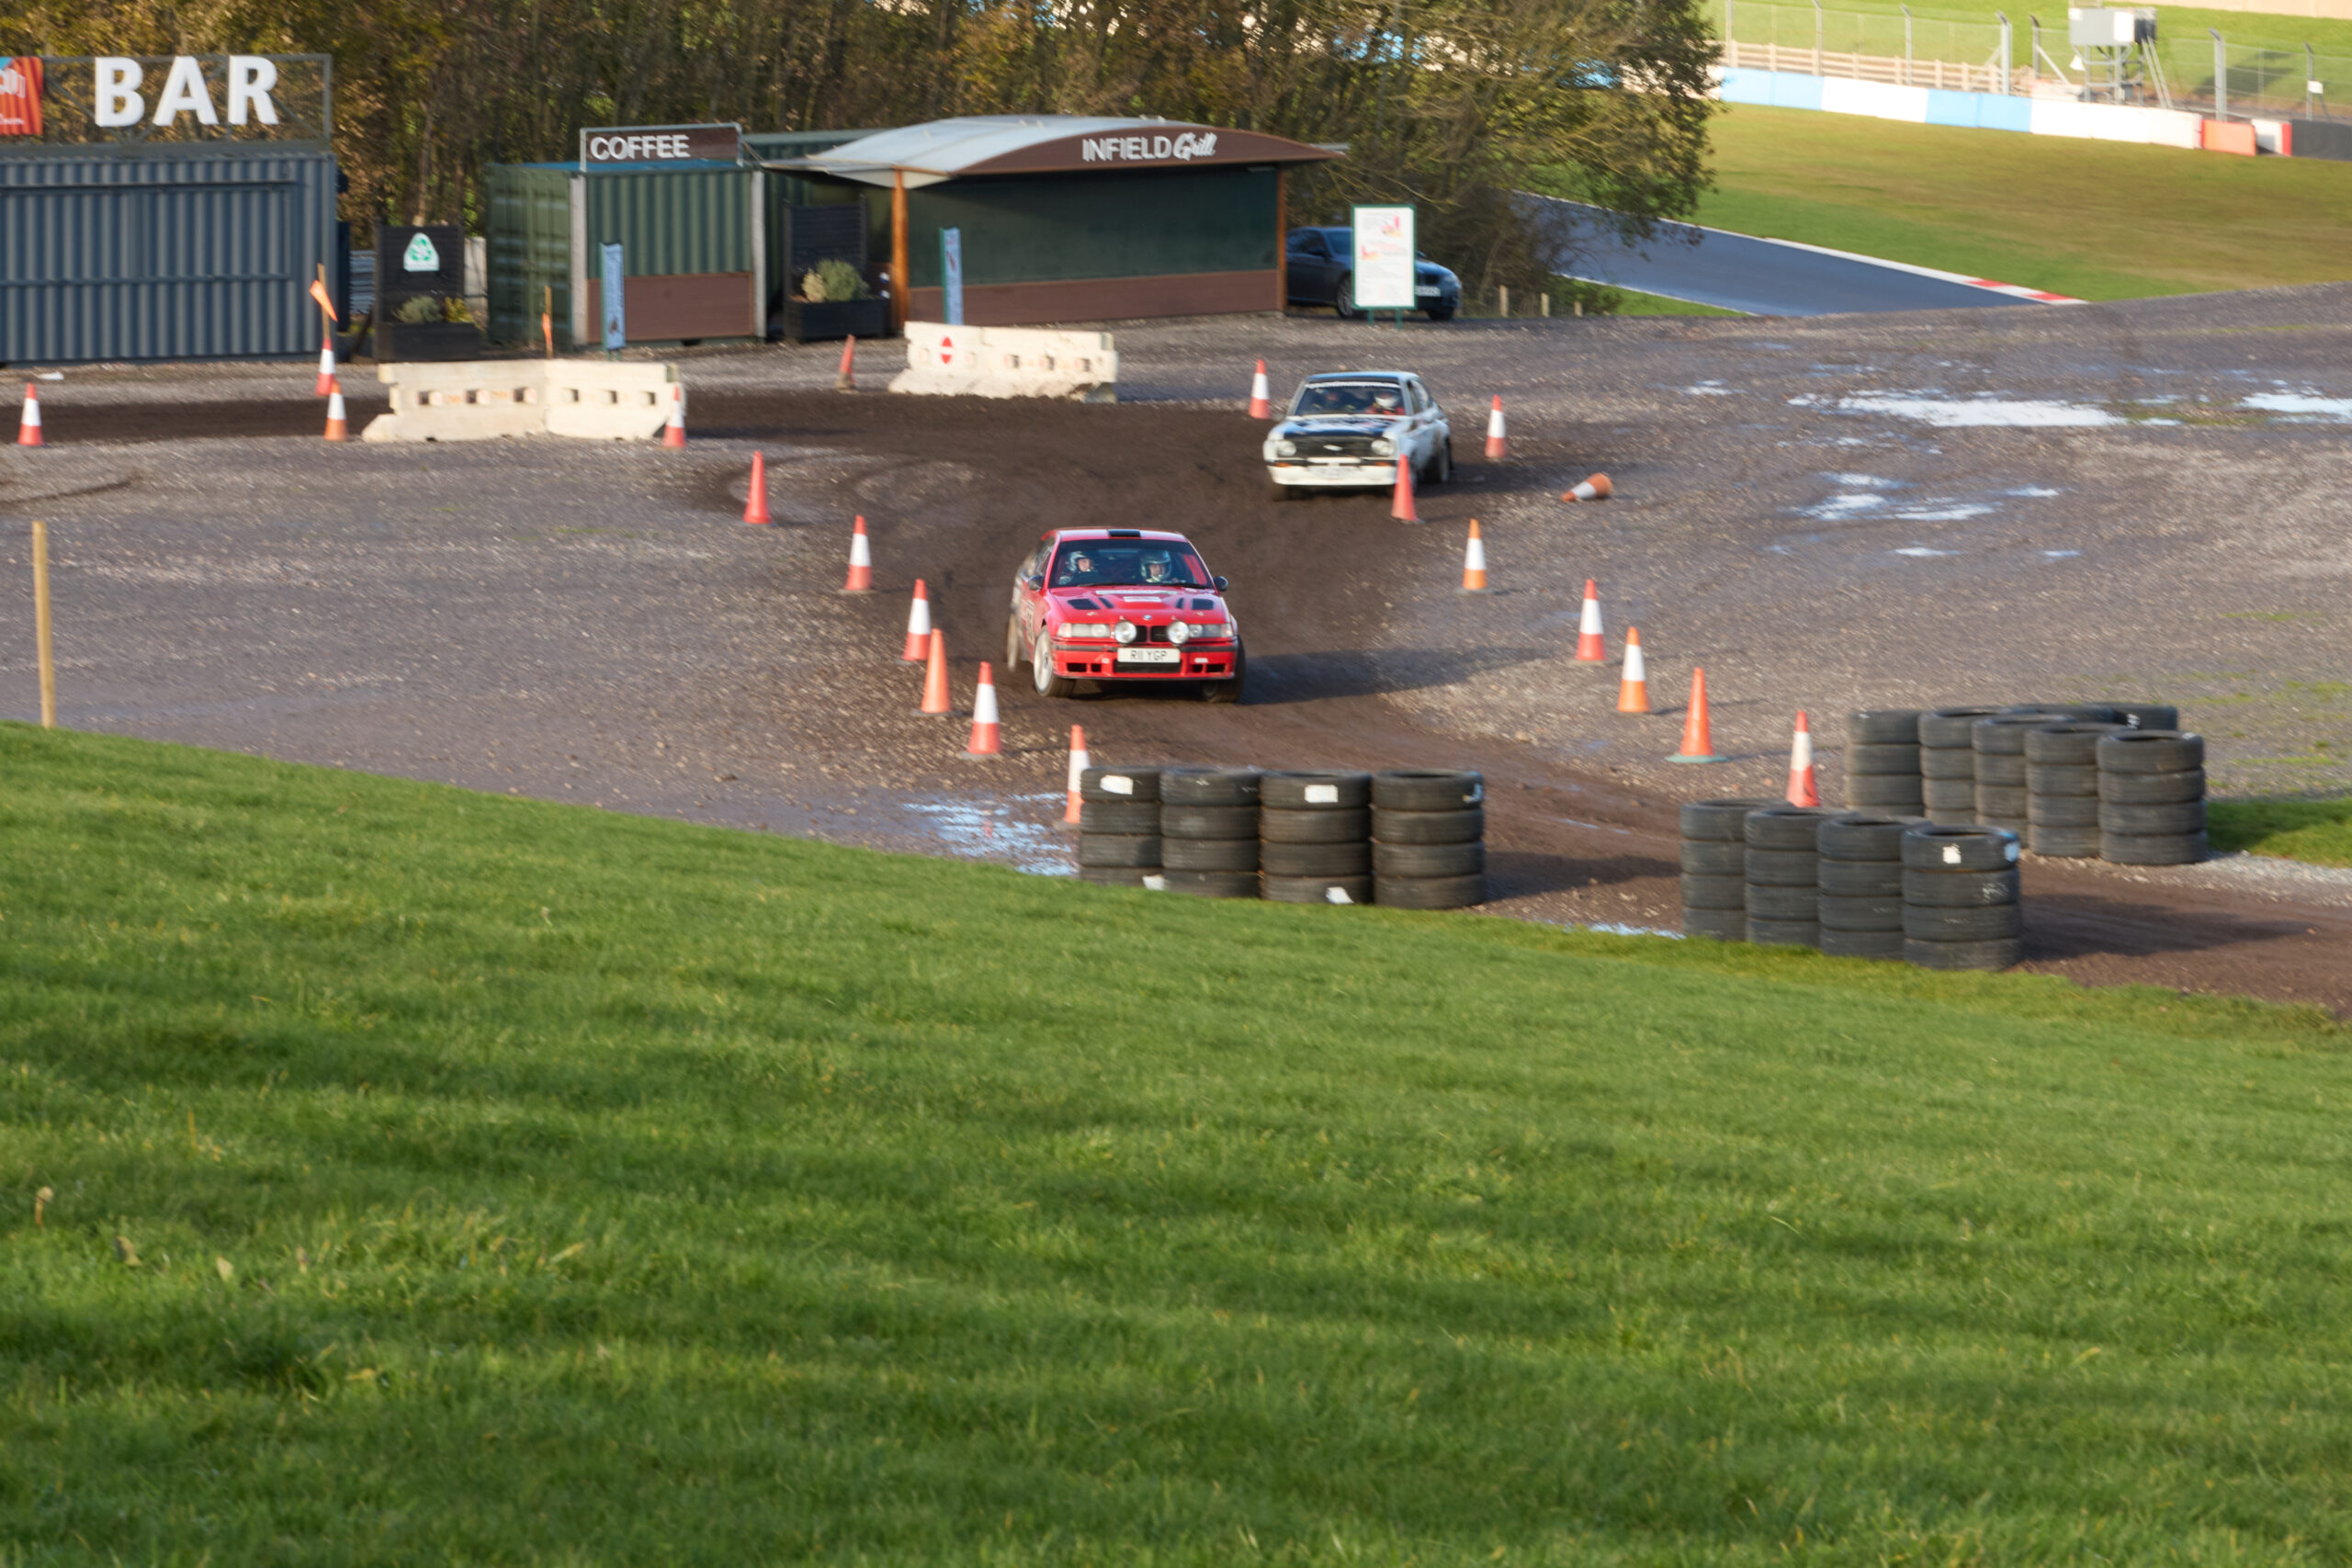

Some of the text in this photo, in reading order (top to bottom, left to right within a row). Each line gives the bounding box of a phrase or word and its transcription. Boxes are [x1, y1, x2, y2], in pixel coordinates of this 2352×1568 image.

[95, 55, 279, 127] BAR
[590, 134, 691, 161] COFFEE
[1082, 131, 1217, 162] INFIELD Grill
